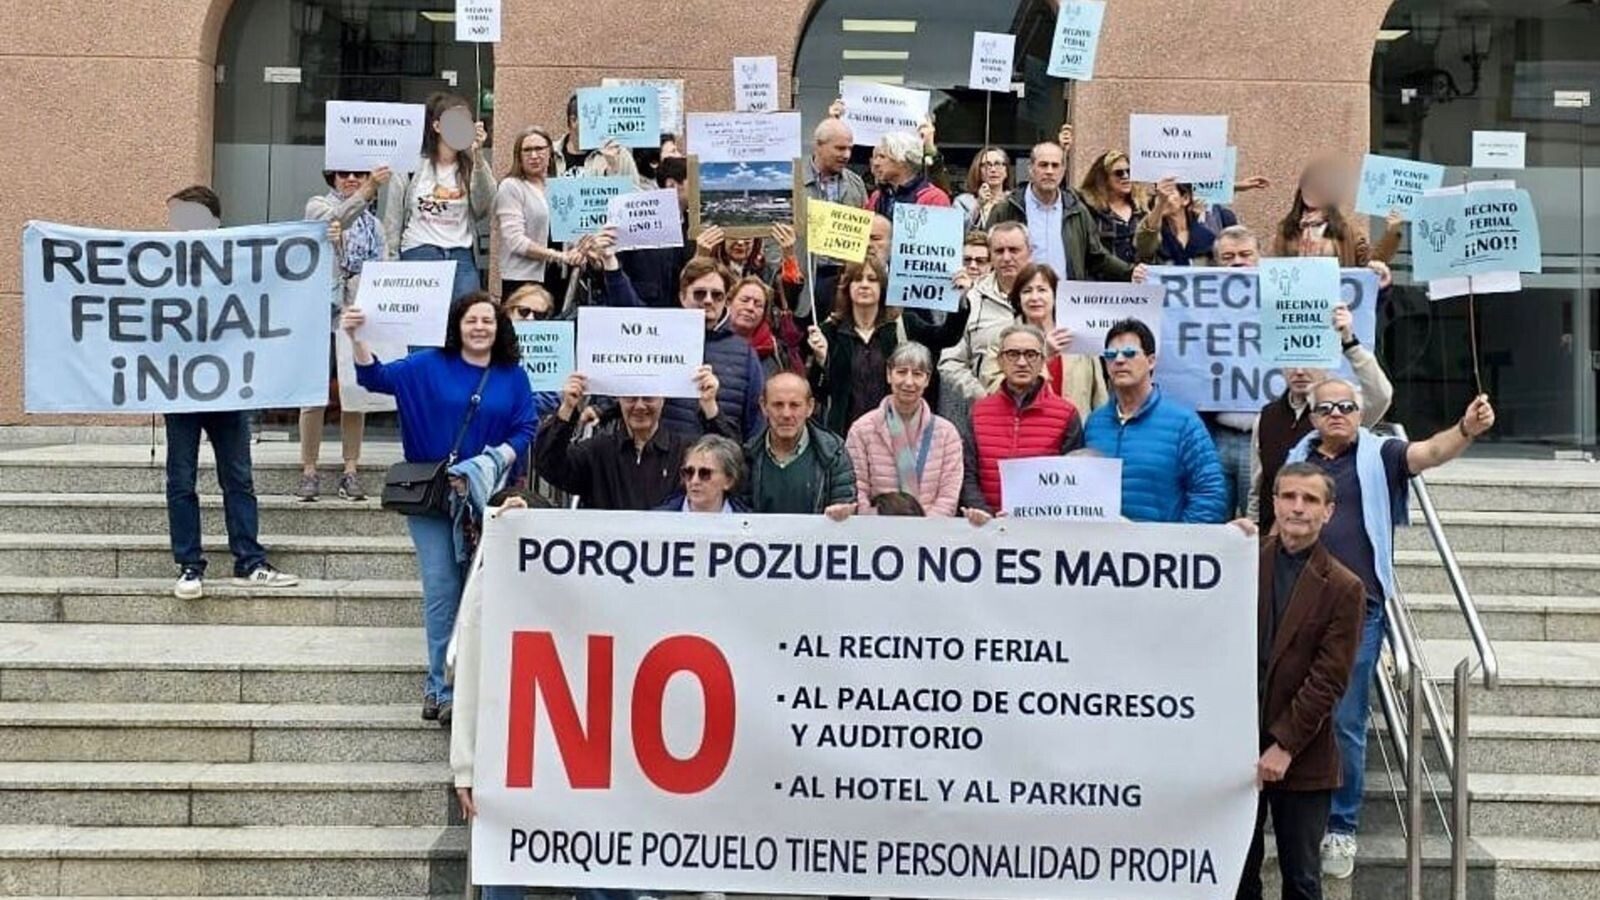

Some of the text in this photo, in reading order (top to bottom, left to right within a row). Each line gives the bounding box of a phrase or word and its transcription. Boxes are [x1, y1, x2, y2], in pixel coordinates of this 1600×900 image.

[608, 96, 646, 104] RECINTO
[612, 106, 641, 114] FERIAL
[353, 116, 412, 126] BOTELLONES
[608, 121, 645, 133] ¡¡NO!!
[1163, 127, 1193, 137] NO AL
[367, 138, 397, 147] RUIDO
[1141, 149, 1212, 159] RECINTO FERIAL
[1392, 168, 1429, 181] RECINTO
[580, 187, 619, 196] RECINTO
[625, 199, 659, 209] RECINTO
[1386, 193, 1413, 206] ¡¡NO
[629, 210, 656, 218] FERIAL
[1464, 202, 1518, 217] RECINTO
[580, 213, 608, 228] ¡¡NO
[831, 210, 871, 225] RECINTO
[1470, 215, 1512, 230] FERIAL
[832, 220, 862, 233] FERIAL
[824, 237, 861, 252] ¡¡NO!!
[900, 243, 956, 257] RECINTO
[1465, 236, 1518, 258] ¡¡NO!!
[42, 237, 320, 288] RECINTO
[904, 259, 948, 273] FERIAL
[383, 278, 440, 288] BOTELLONES
[902, 284, 945, 301] ¡NO!
[1160, 274, 1363, 309] RECIO
[1070, 295, 1150, 305] NI BOTELLONES
[1276, 299, 1329, 310] RECINTO
[389, 303, 419, 313] RUIDO
[71, 293, 291, 342] FERIAL
[1282, 313, 1323, 323] FERIAL
[621, 323, 660, 336] NO AL
[1178, 322, 1261, 357] FER
[1283, 334, 1321, 352] ¡NO!
[592, 353, 688, 365] RECINTO FERIAL
[526, 361, 558, 374] NO!!
[111, 351, 255, 406] ¡NO!
[1210, 362, 1286, 401] ¡NO
[1038, 472, 1079, 486] NO AL
[1013, 505, 1104, 517] RECINTO FERIAL
[518, 538, 1222, 590] PORQUE POZUELO NO ES MADRID
[794, 635, 1069, 663] AL RECINTO FERIAL
[792, 686, 1195, 719] AL PALACIO DE CONGRESOS
[505, 630, 736, 794] NO
[791, 724, 983, 750] Y AUDITORIO
[789, 776, 1142, 807] AL HOTEL Y AL PARKING
[509, 828, 1217, 884] PORQUE POZUELO TIENE PERSONALIDAD PROPIA
